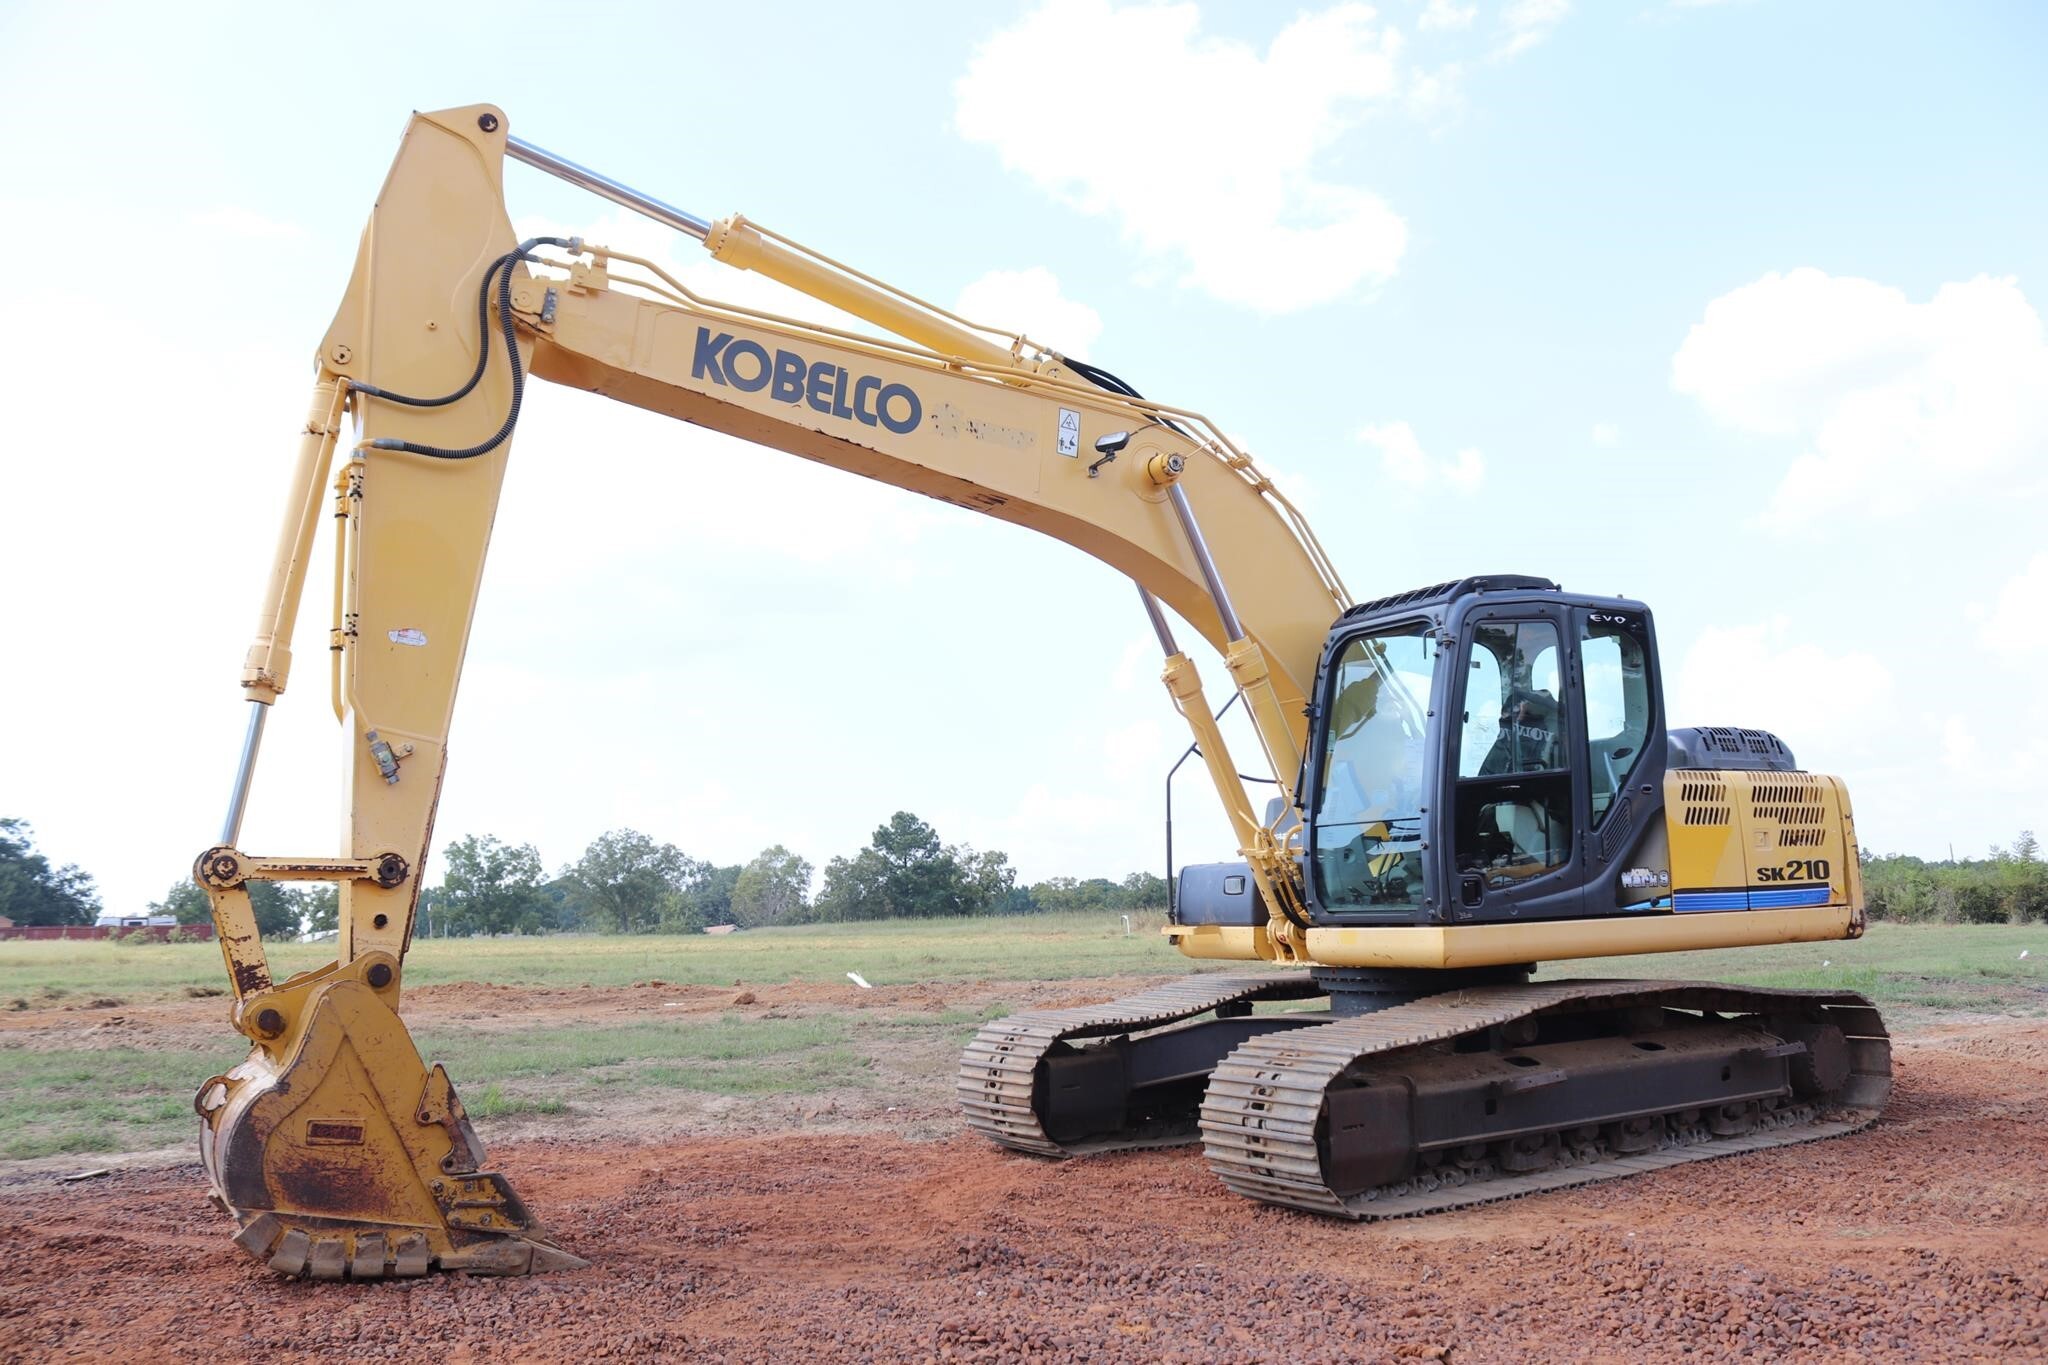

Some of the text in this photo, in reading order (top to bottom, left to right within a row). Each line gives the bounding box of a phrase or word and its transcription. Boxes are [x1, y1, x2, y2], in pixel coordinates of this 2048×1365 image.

[691, 326, 922, 434] KOBELCO
[1590, 614, 1627, 625] EVO
[1757, 860, 1830, 881] SK210
